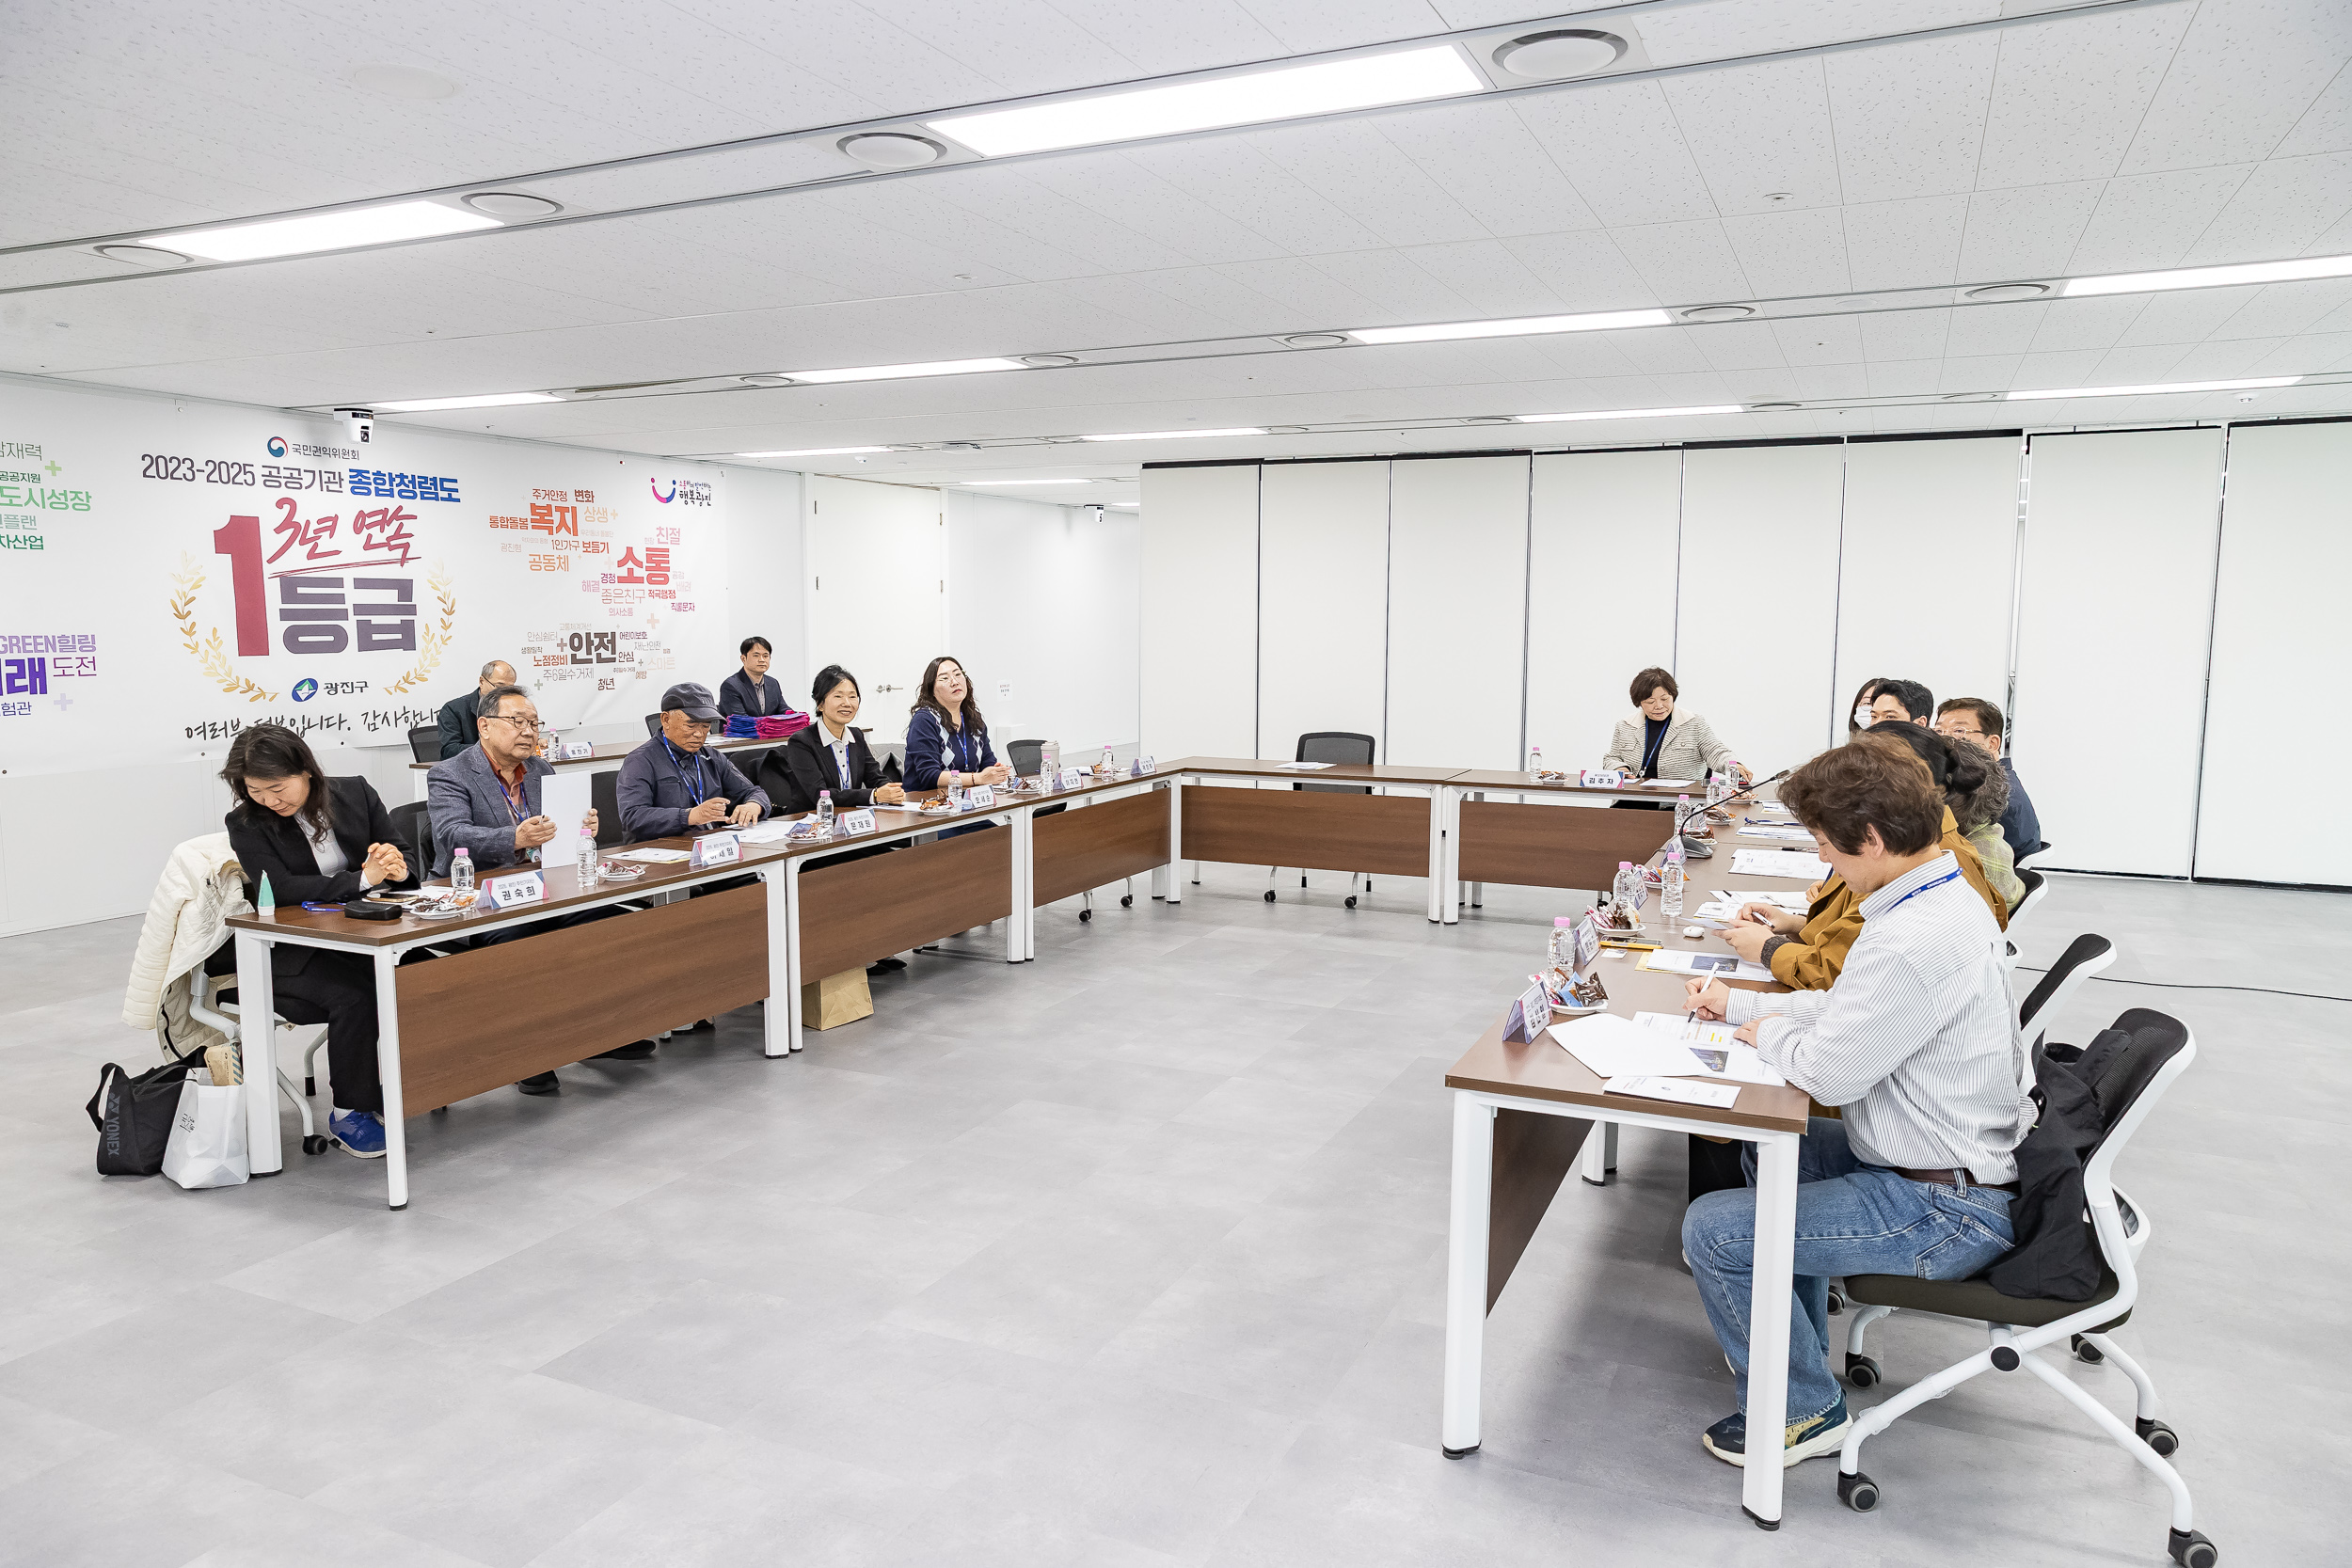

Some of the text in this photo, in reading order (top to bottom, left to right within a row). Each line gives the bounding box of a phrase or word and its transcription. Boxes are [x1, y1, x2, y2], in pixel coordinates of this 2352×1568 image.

[293, 443, 359, 461] 국민권익위원회
[140, 453, 461, 503] 2023-2025 공공기관 종합청렴도
[0, 485, 92, 512] 도시성장
[532, 488, 596, 503] 주거안정 변화
[679, 489, 712, 507] 행복광진
[0, 513, 38, 531] 플랜
[530, 502, 579, 537] 복지
[583, 505, 609, 523] 상생
[488, 515, 529, 531] 통합돌봄
[266, 497, 418, 568] 3년 연속
[656, 526, 681, 546] 친절
[551, 539, 610, 554] 1인가구 보듬기
[528, 553, 569, 572] 공동체
[616, 546, 671, 586] 소통
[581, 579, 600, 593] 해결
[647, 589, 676, 600] 적극행정
[601, 588, 645, 605] 좋은친구
[619, 631, 648, 641] 어린이보호
[568, 631, 617, 665] 안전
[532, 655, 568, 667] 노점정비
[618, 651, 635, 663] 안심
[646, 657, 676, 671] 스마트
[0, 656, 97, 697] 래 도전
[543, 668, 595, 682] 주6일수거제
[323, 680, 370, 696] 광진구
[597, 677, 616, 691] 청년
[501, 885, 536, 901] 권숙희
[106, 1117, 120, 1156] YONEX
